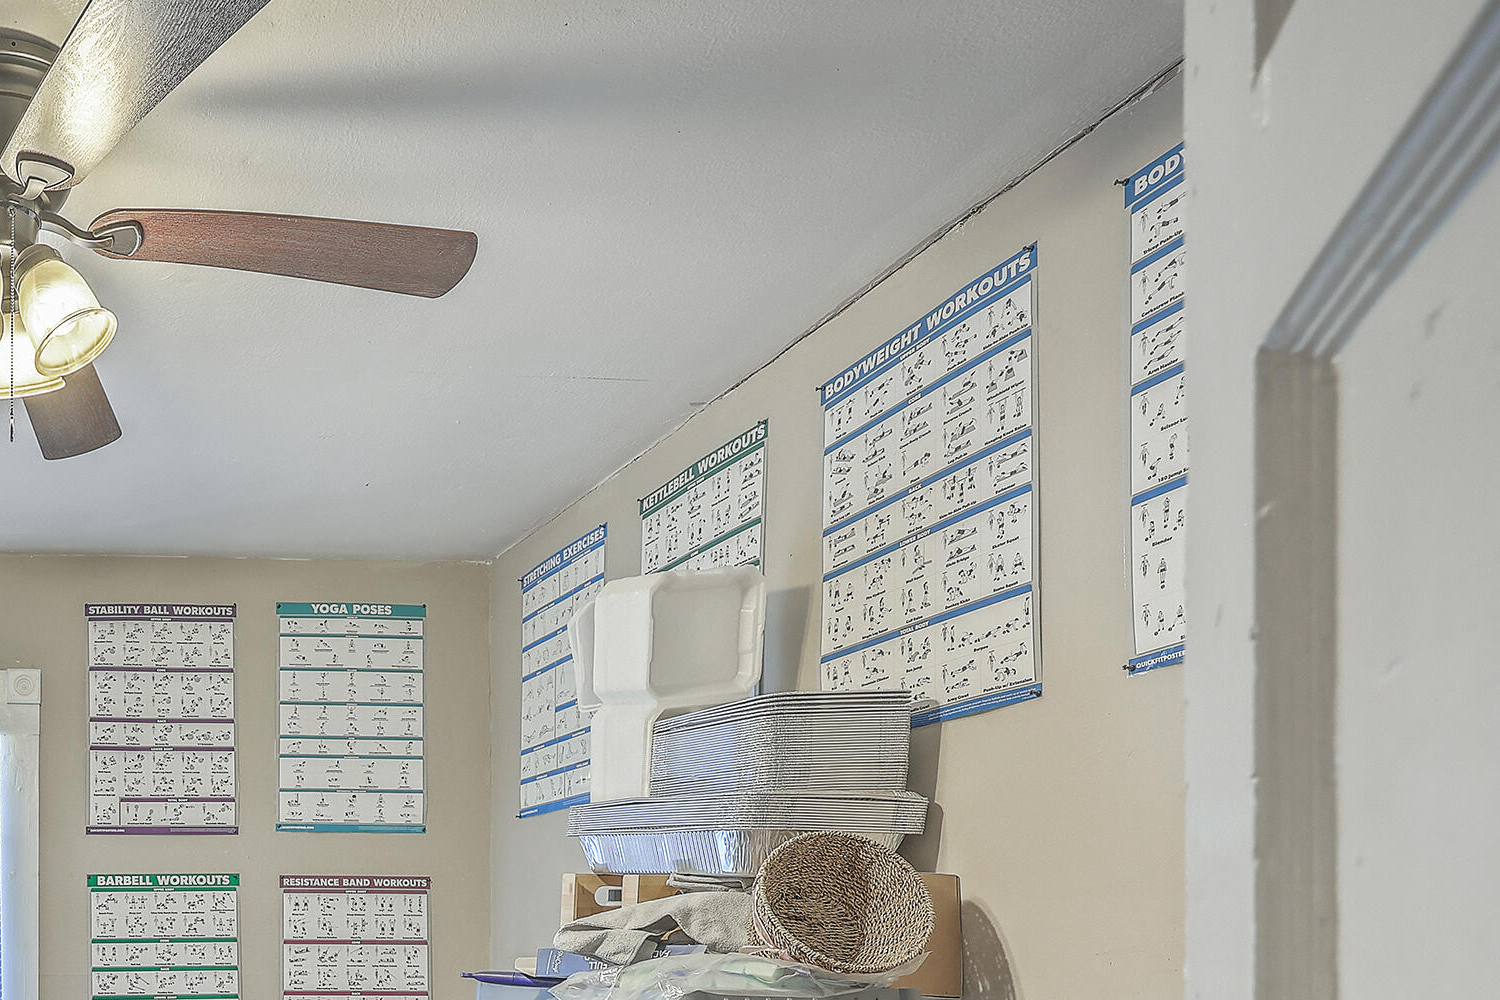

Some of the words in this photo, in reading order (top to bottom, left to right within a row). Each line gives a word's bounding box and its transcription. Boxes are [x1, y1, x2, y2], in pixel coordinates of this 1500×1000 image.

[1134, 149, 1185, 196] BOD
[824, 323, 922, 400] BODYWEIGHT
[926, 251, 1032, 331] WORKOUTS
[642, 467, 695, 512] KETTLEBELL
[698, 424, 765, 474] WORKOUTS
[523, 553, 561, 588] STRETCHING
[562, 527, 605, 561] EXERCISES
[88, 605, 140, 615] STABILITY
[143, 605, 170, 615] BALL
[172, 606, 233, 616] WORKOUTS
[311, 603, 348, 614] YOGA
[352, 604, 392, 615] POSES
[97, 875, 153, 886] BARBELL
[157, 875, 230, 886] WORKOUTS
[283, 878, 340, 887] RESISTANCE
[342, 878, 371, 887] BAND
[373, 878, 428, 888] WORKOUTS
